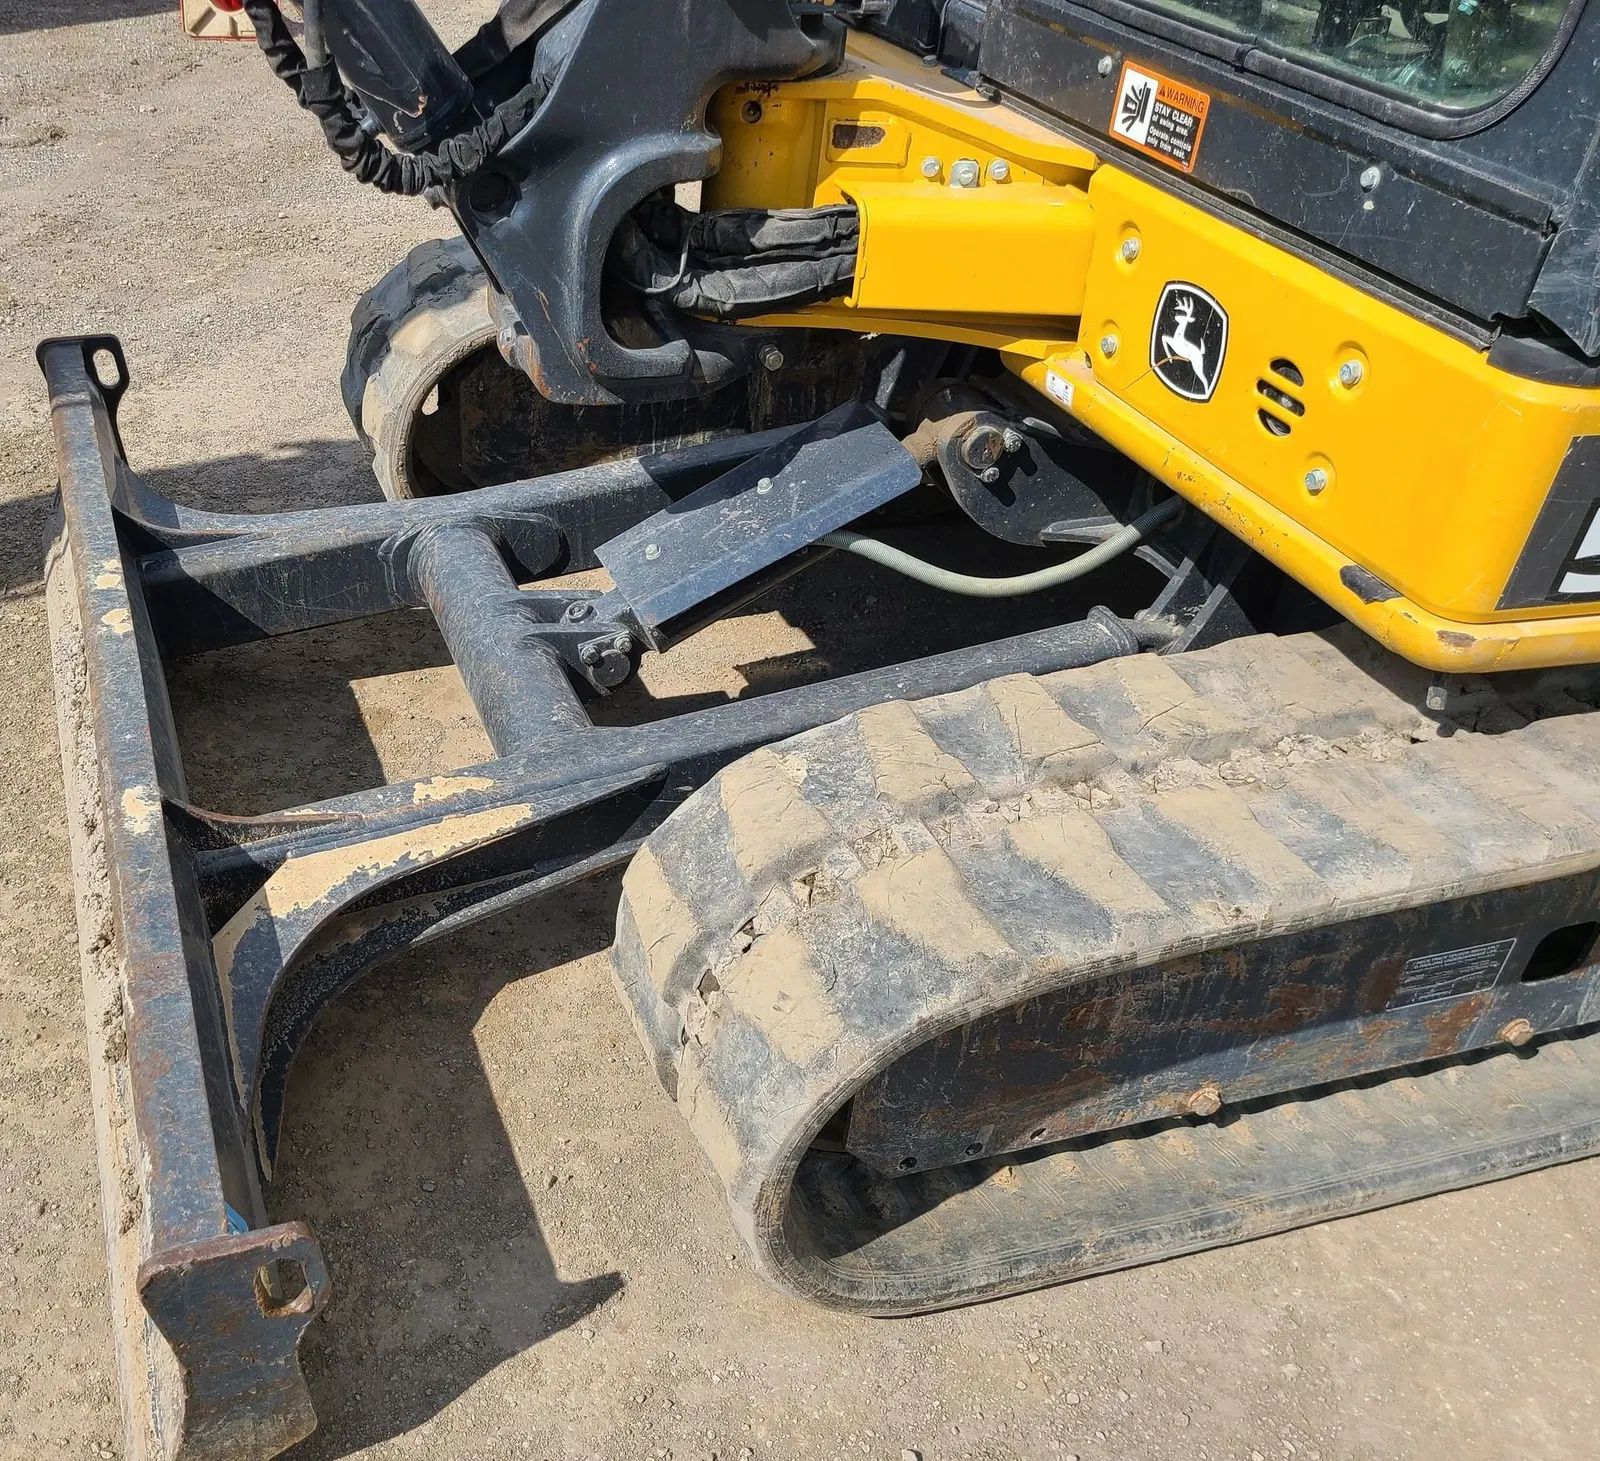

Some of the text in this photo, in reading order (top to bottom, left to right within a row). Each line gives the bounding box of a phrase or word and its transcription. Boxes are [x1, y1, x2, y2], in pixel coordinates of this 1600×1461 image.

[1167, 87, 1205, 113] WARNING
[1151, 114, 1159, 122] of
[1159, 117, 1175, 131] swing
[1154, 102, 1193, 128] STAY CLEAR
[1147, 136, 1158, 148] only
[1160, 140, 1171, 152] from
[1149, 125, 1192, 152] Operate controls
